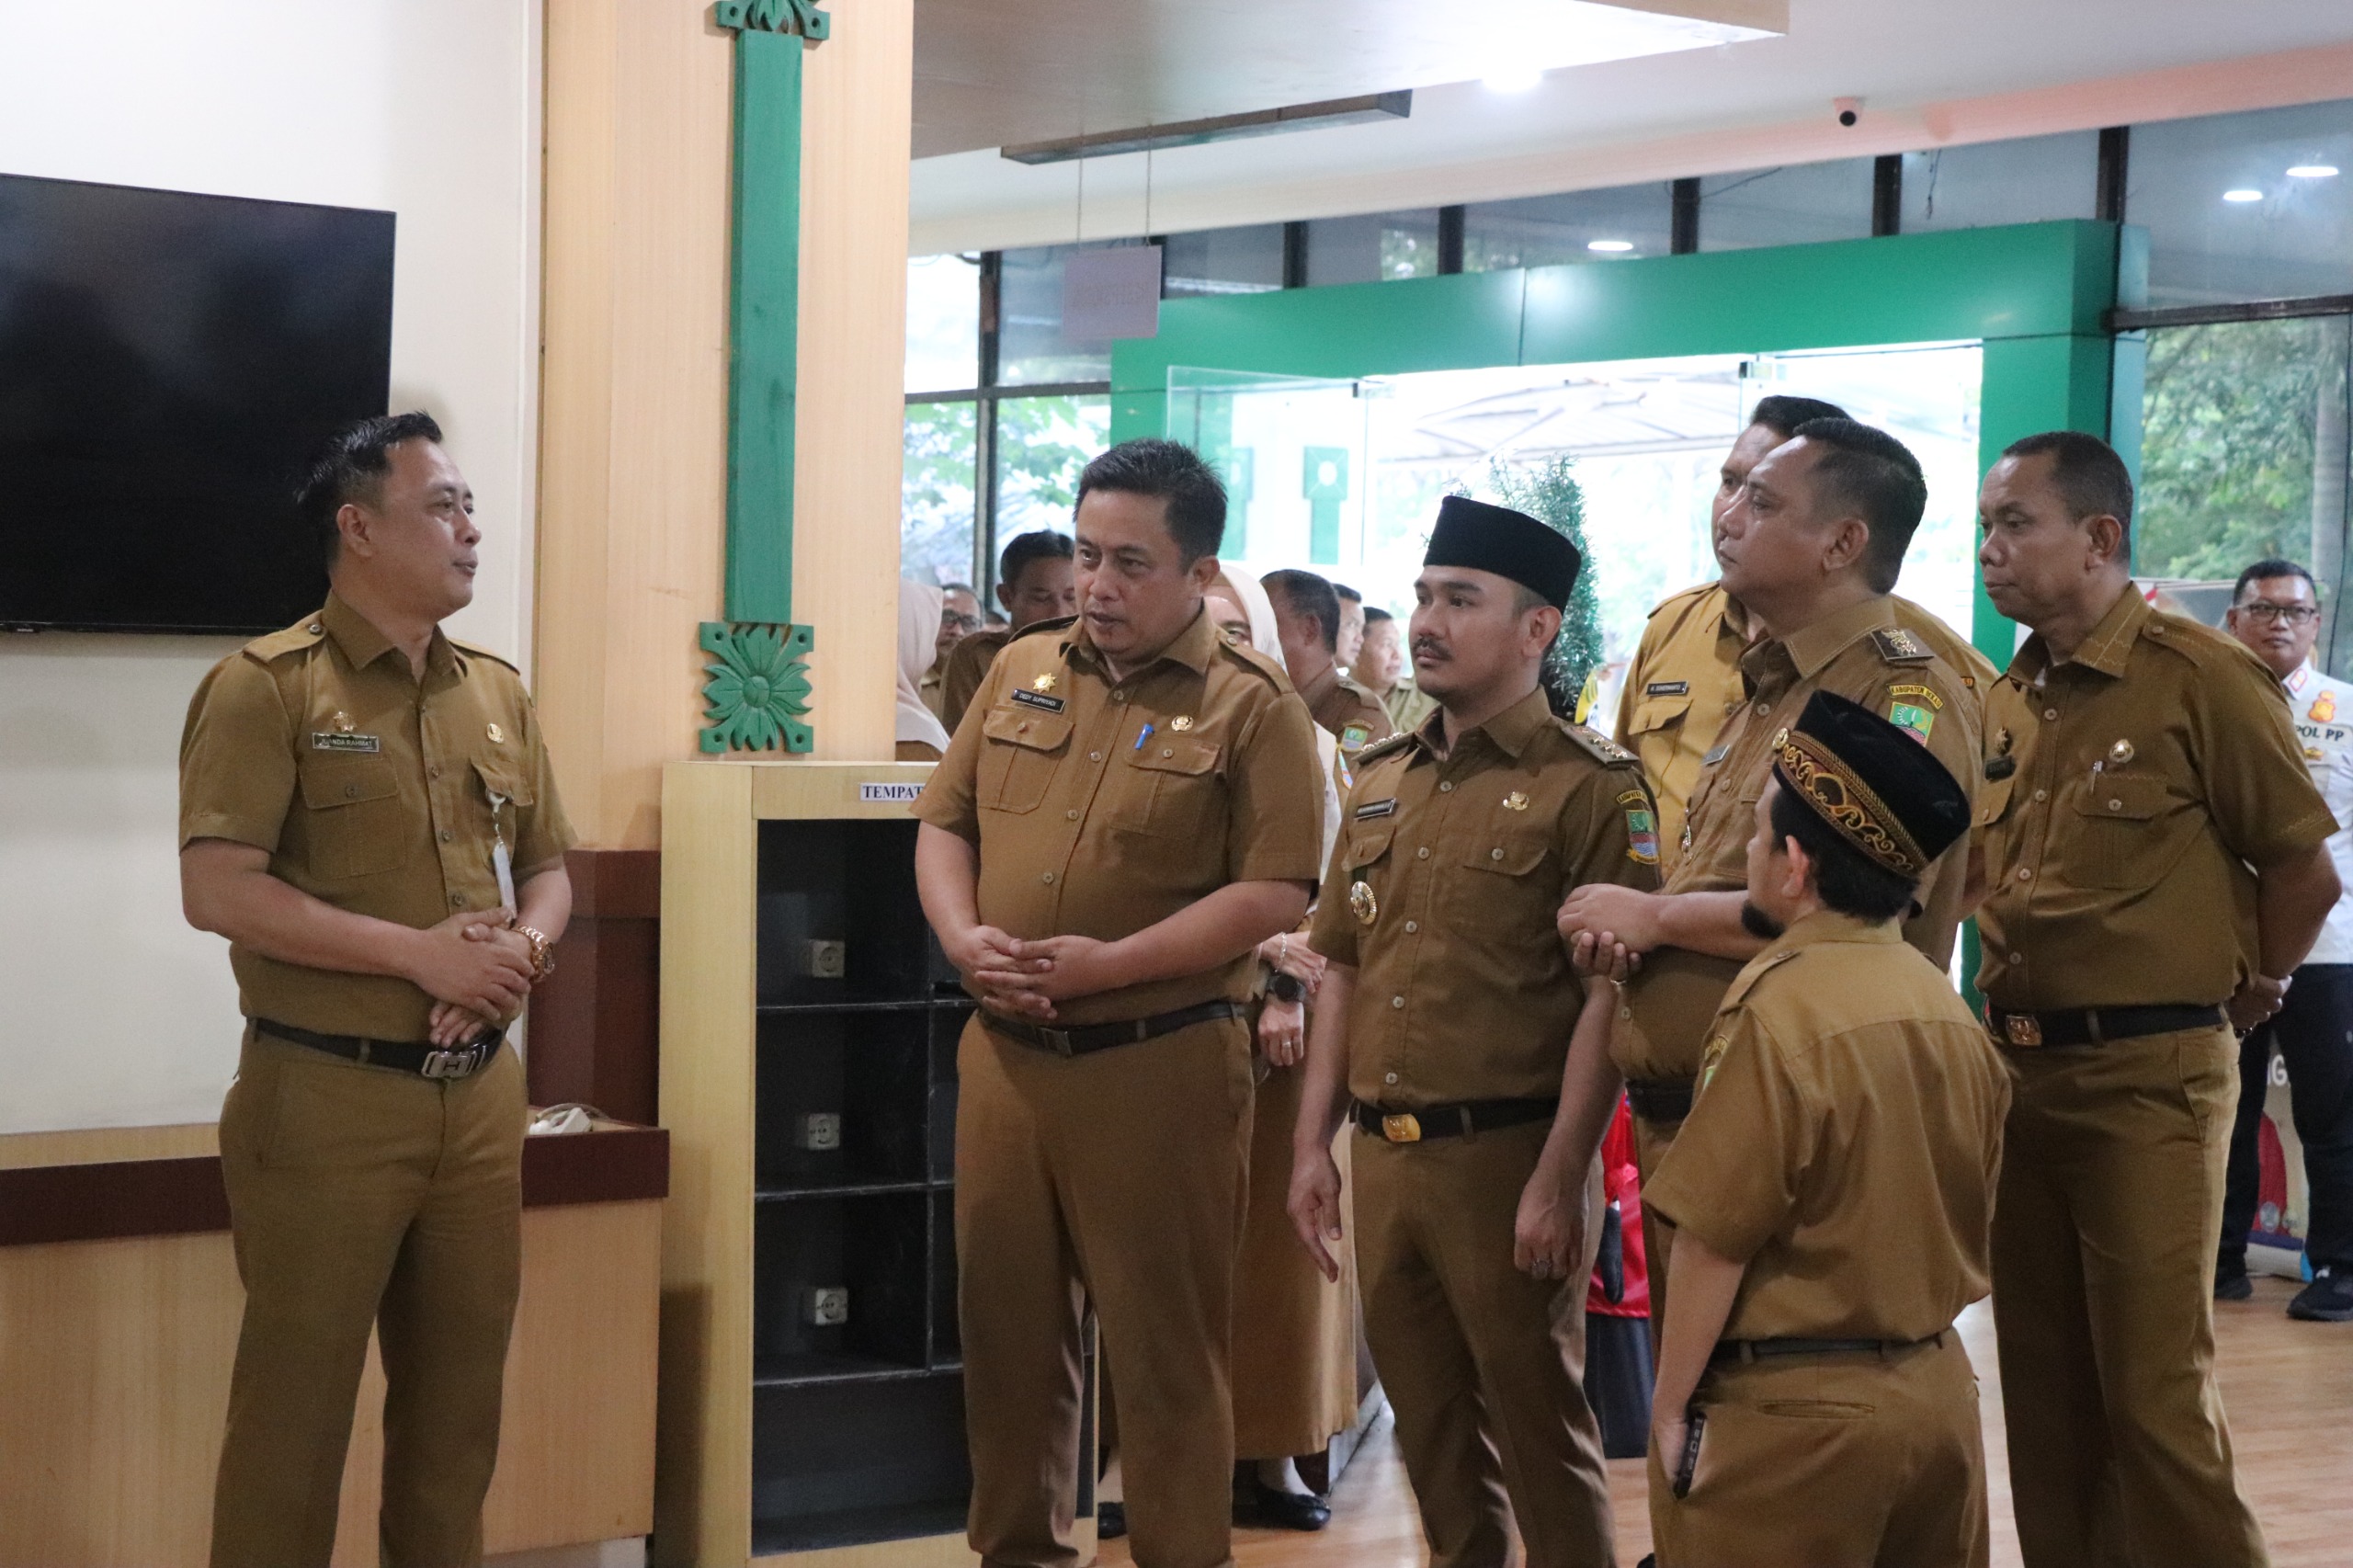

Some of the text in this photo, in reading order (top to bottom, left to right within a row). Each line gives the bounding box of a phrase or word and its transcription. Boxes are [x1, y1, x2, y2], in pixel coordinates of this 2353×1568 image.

[1891, 685, 1924, 694] KABUPATEN
[1018, 692, 1057, 707] DEDY SUPRIYADI
[2325, 728, 2345, 742] PP
[862, 785, 924, 799] TEMPAT
